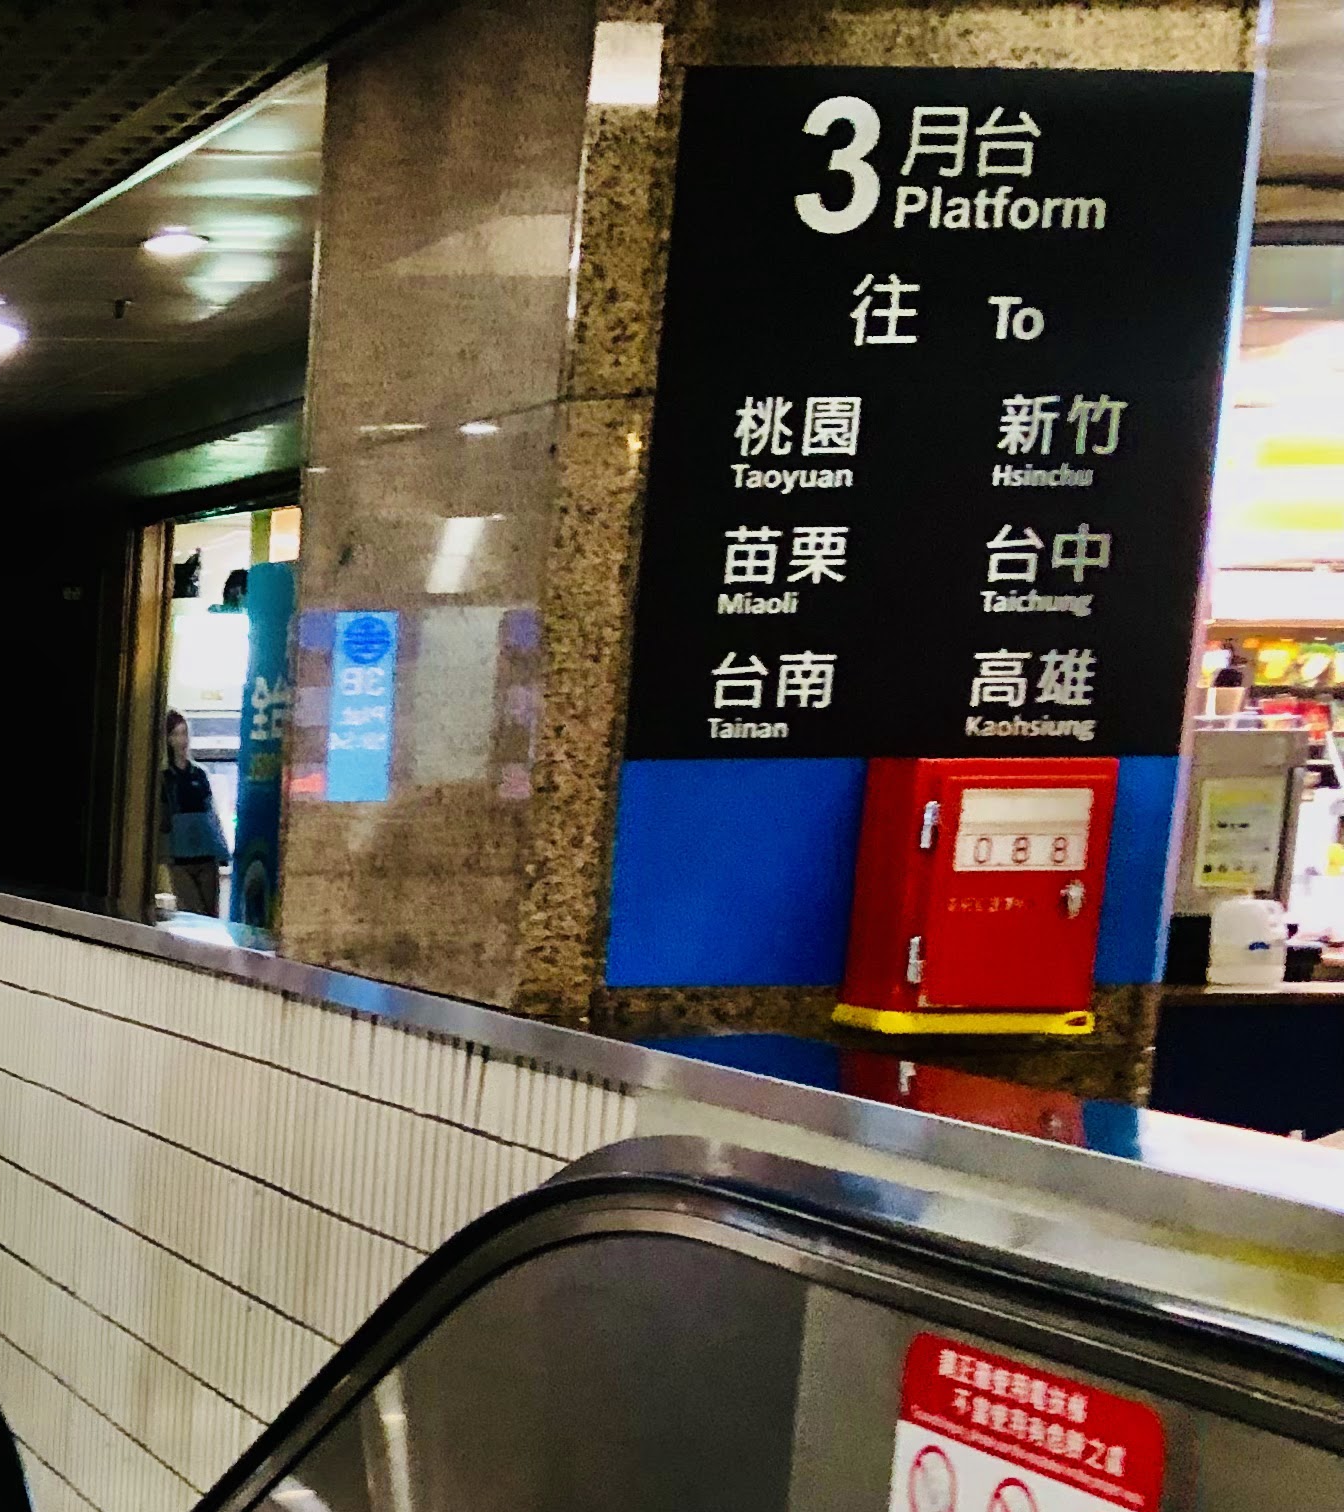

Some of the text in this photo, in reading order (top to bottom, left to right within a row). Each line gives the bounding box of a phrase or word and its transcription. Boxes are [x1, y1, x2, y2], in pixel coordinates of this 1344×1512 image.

[795, 96, 880, 235] 3
[899, 106, 1041, 177] 月台
[894, 186, 1106, 230] Platform
[850, 274, 920, 346] 往
[988, 296, 1044, 340] To
[734, 396, 861, 457] 桃園
[997, 394, 1128, 455] 新竹
[731, 463, 853, 495] Taoyuan
[993, 464, 1094, 488] Hsinchu
[723, 526, 849, 584] 苗栗
[986, 523, 1111, 582] 台中
[717, 592, 798, 615] Miaoli
[980, 590, 1092, 616] Taichung
[710, 650, 837, 709] 台南
[969, 648, 1097, 707] 高雄
[707, 718, 789, 739] Tainan
[965, 715, 1096, 741] Kaohsiung
